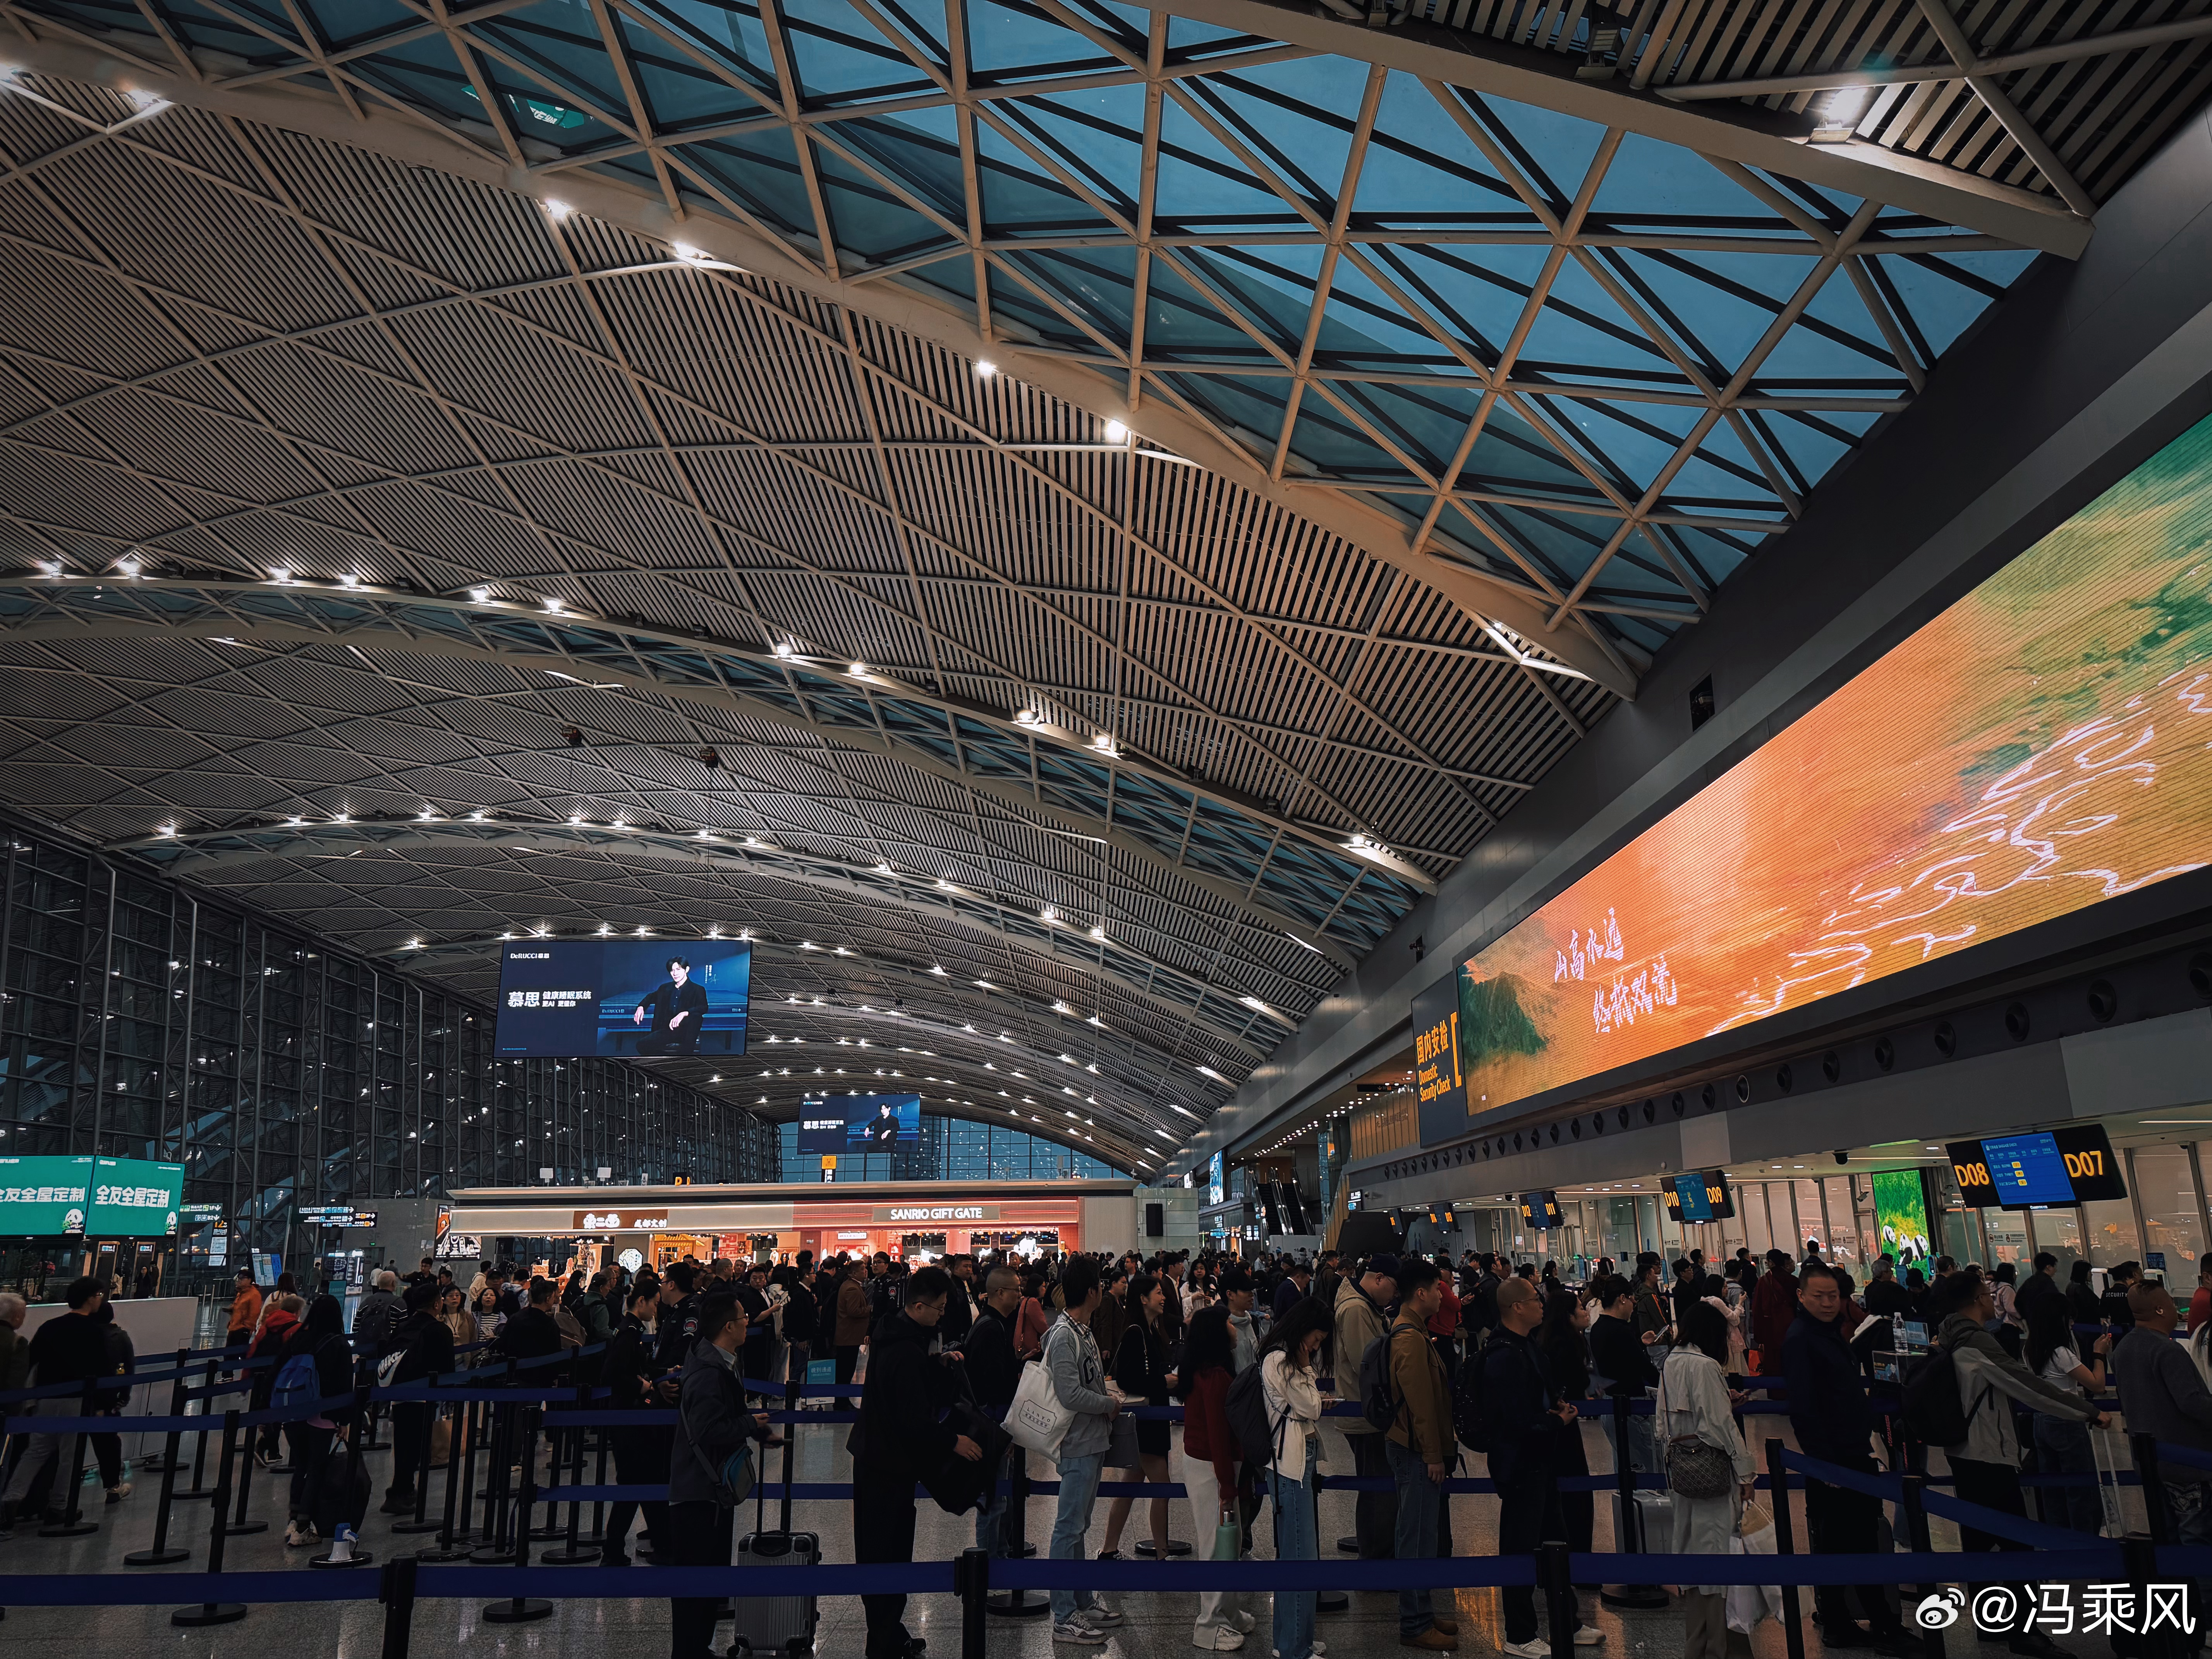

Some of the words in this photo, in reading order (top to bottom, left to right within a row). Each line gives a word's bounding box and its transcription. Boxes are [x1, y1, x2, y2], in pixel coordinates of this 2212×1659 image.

[508, 991, 540, 1007] 慕思
[543, 991, 591, 999] 健康睡眠系统
[1416, 1020, 1449, 1065] 国内安检
[1419, 1063, 1438, 1085] Domestic
[1420, 1083, 1437, 1102] Security
[1437, 1075, 1451, 1095] Check
[2064, 1151, 2104, 1178] D07
[1954, 1163, 1990, 1187] D08
[95, 1185, 170, 1207] 全友全屋定制
[1664, 1192, 1680, 1207] D10
[1706, 1187, 1723, 1204] D09
[891, 1209, 929, 1220] SANRIO
[931, 1208, 954, 1219] GIFT
[955, 1207, 982, 1219] GATE
[1522, 1205, 1532, 1217] D12
[1545, 1202, 1556, 1215] D11
[378, 1351, 401, 1378] NIKE
